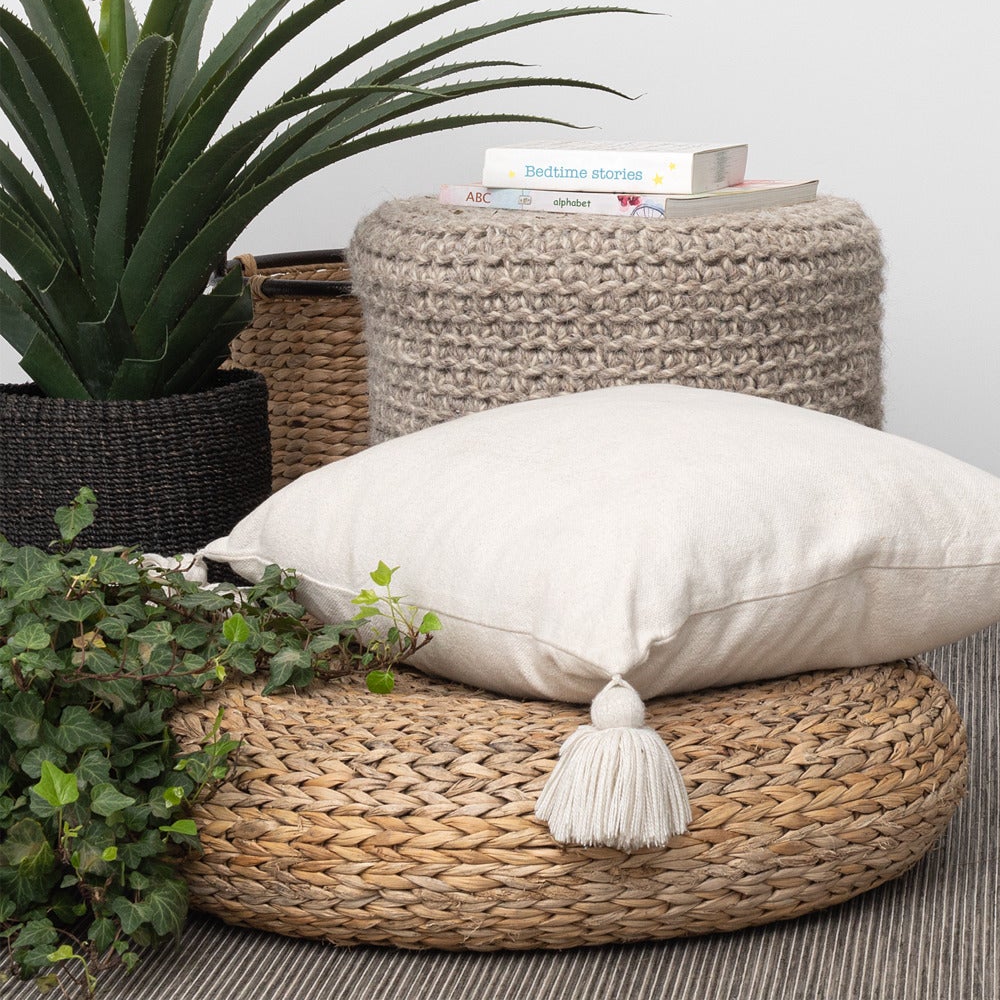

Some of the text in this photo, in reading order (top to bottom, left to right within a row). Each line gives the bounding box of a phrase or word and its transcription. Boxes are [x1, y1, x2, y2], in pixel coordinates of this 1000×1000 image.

[525, 165, 643, 181] Bedtime stories
[465, 191, 492, 204] ABC
[553, 197, 591, 208] alphabet
